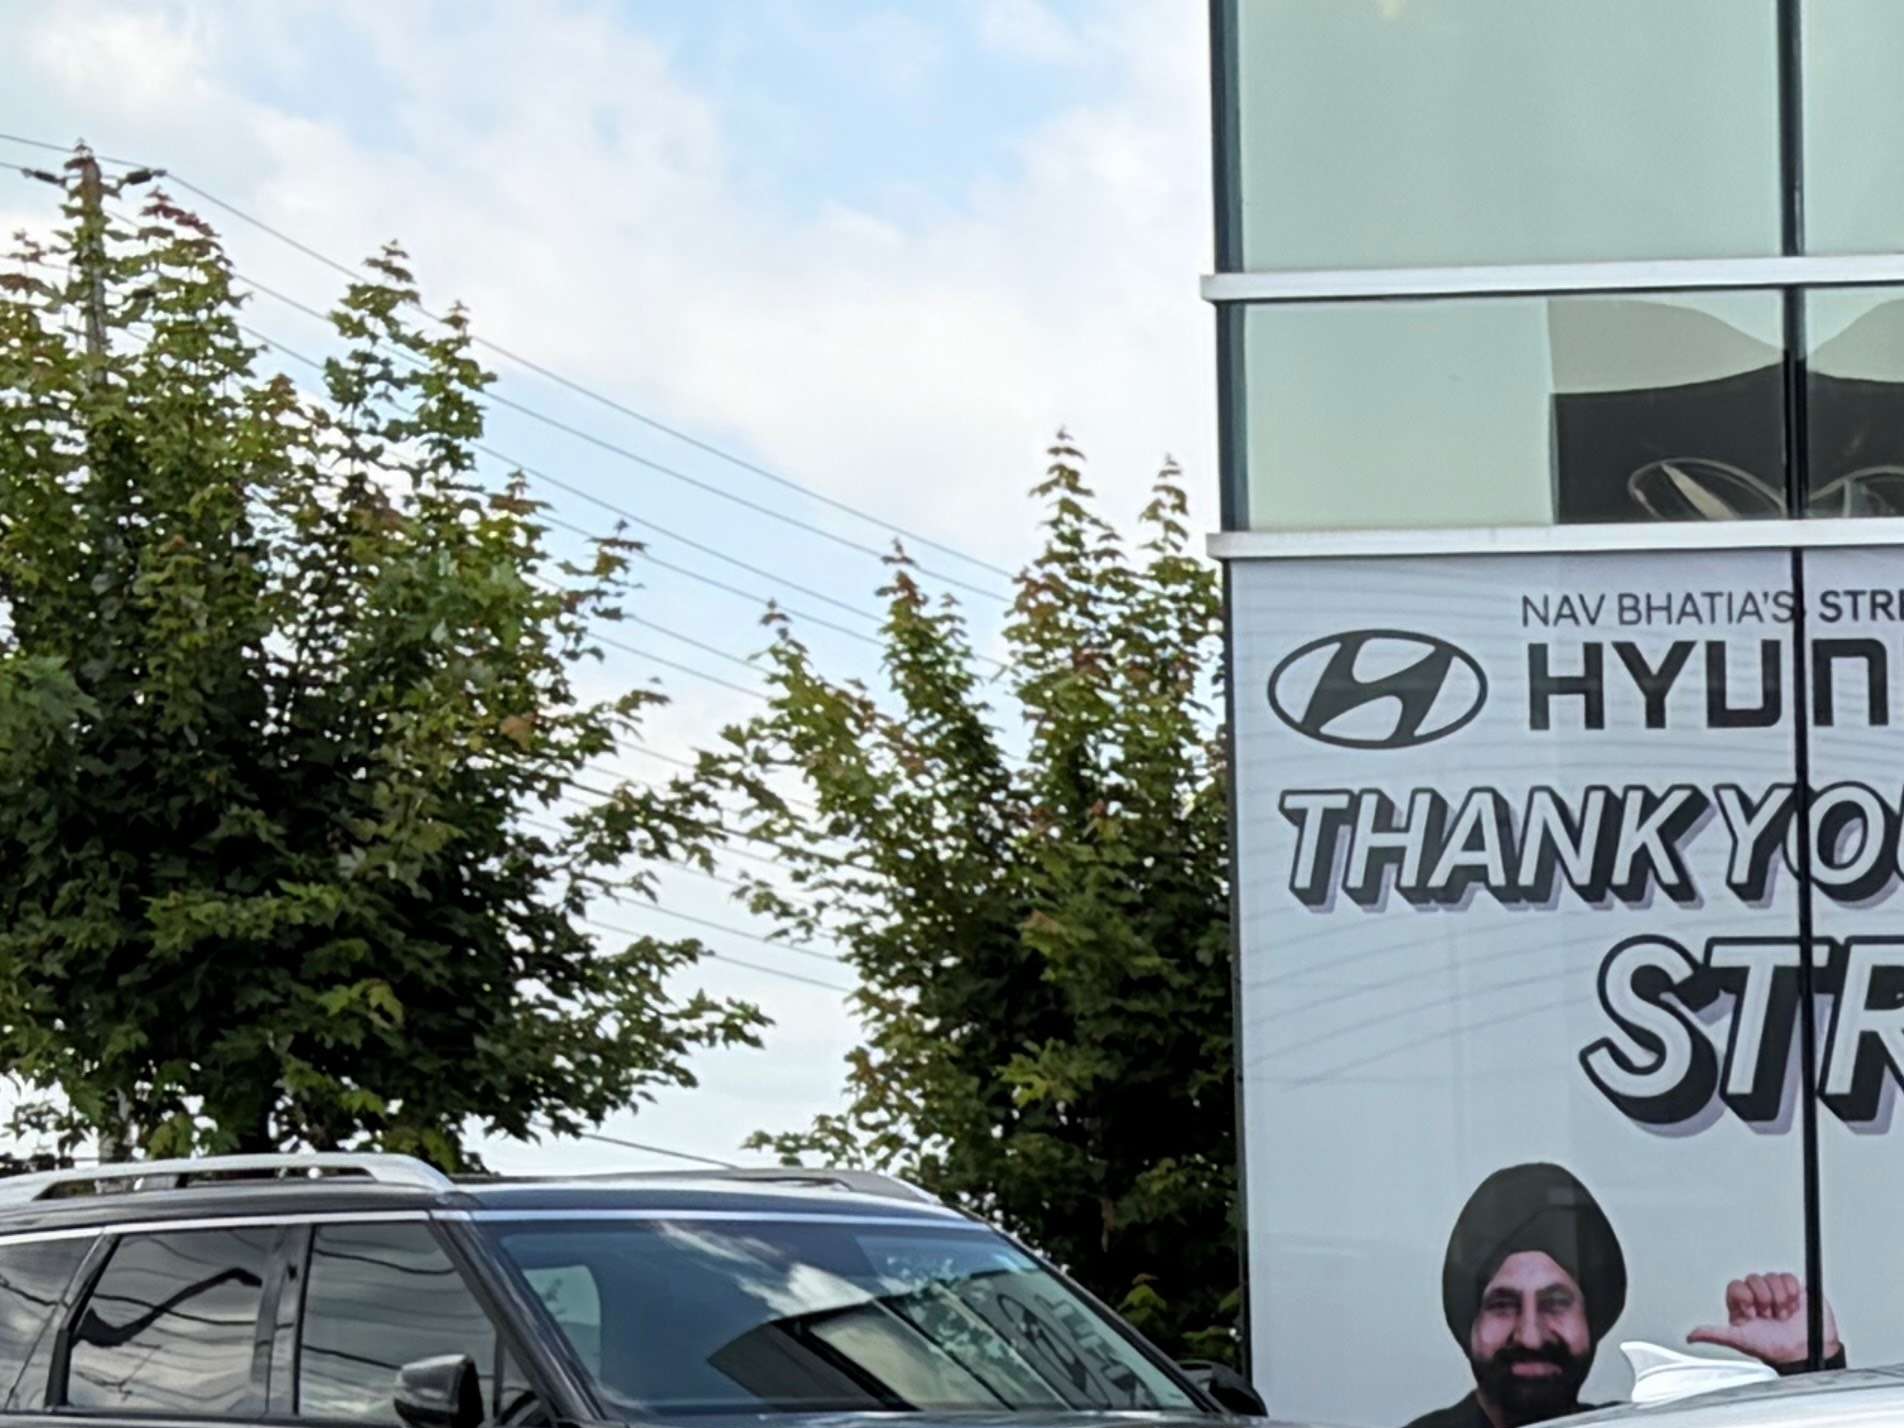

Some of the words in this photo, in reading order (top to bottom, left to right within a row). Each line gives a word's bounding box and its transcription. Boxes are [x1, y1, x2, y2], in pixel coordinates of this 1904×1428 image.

[1521, 594, 1605, 627] NAV
[1618, 590, 1796, 626] BHATIA'S
[1280, 785, 1706, 906] THANK
